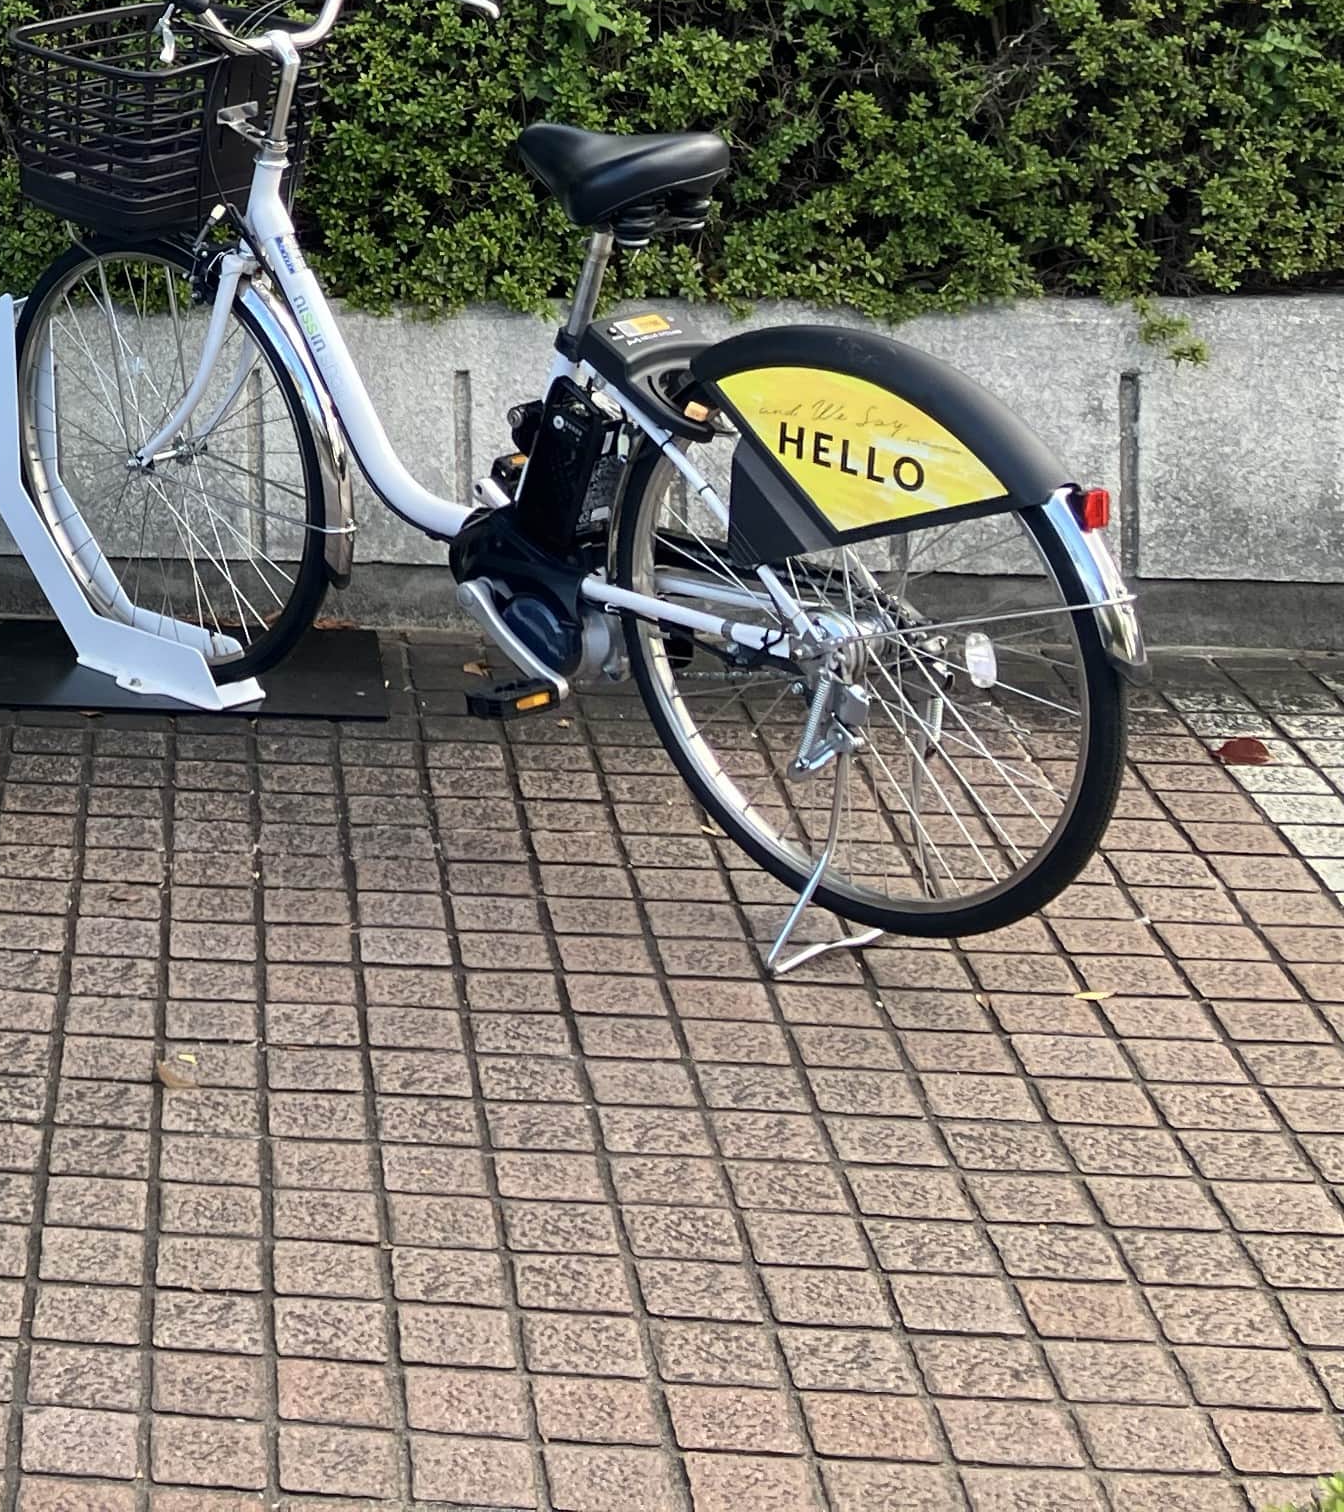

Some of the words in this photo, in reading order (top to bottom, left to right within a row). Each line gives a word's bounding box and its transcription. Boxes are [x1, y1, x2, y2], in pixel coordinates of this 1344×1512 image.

[293, 295, 327, 353] nissin
[759, 403, 803, 417] and
[812, 399, 849, 421] We
[856, 405, 908, 437] Say
[778, 421, 924, 491] HELLO
